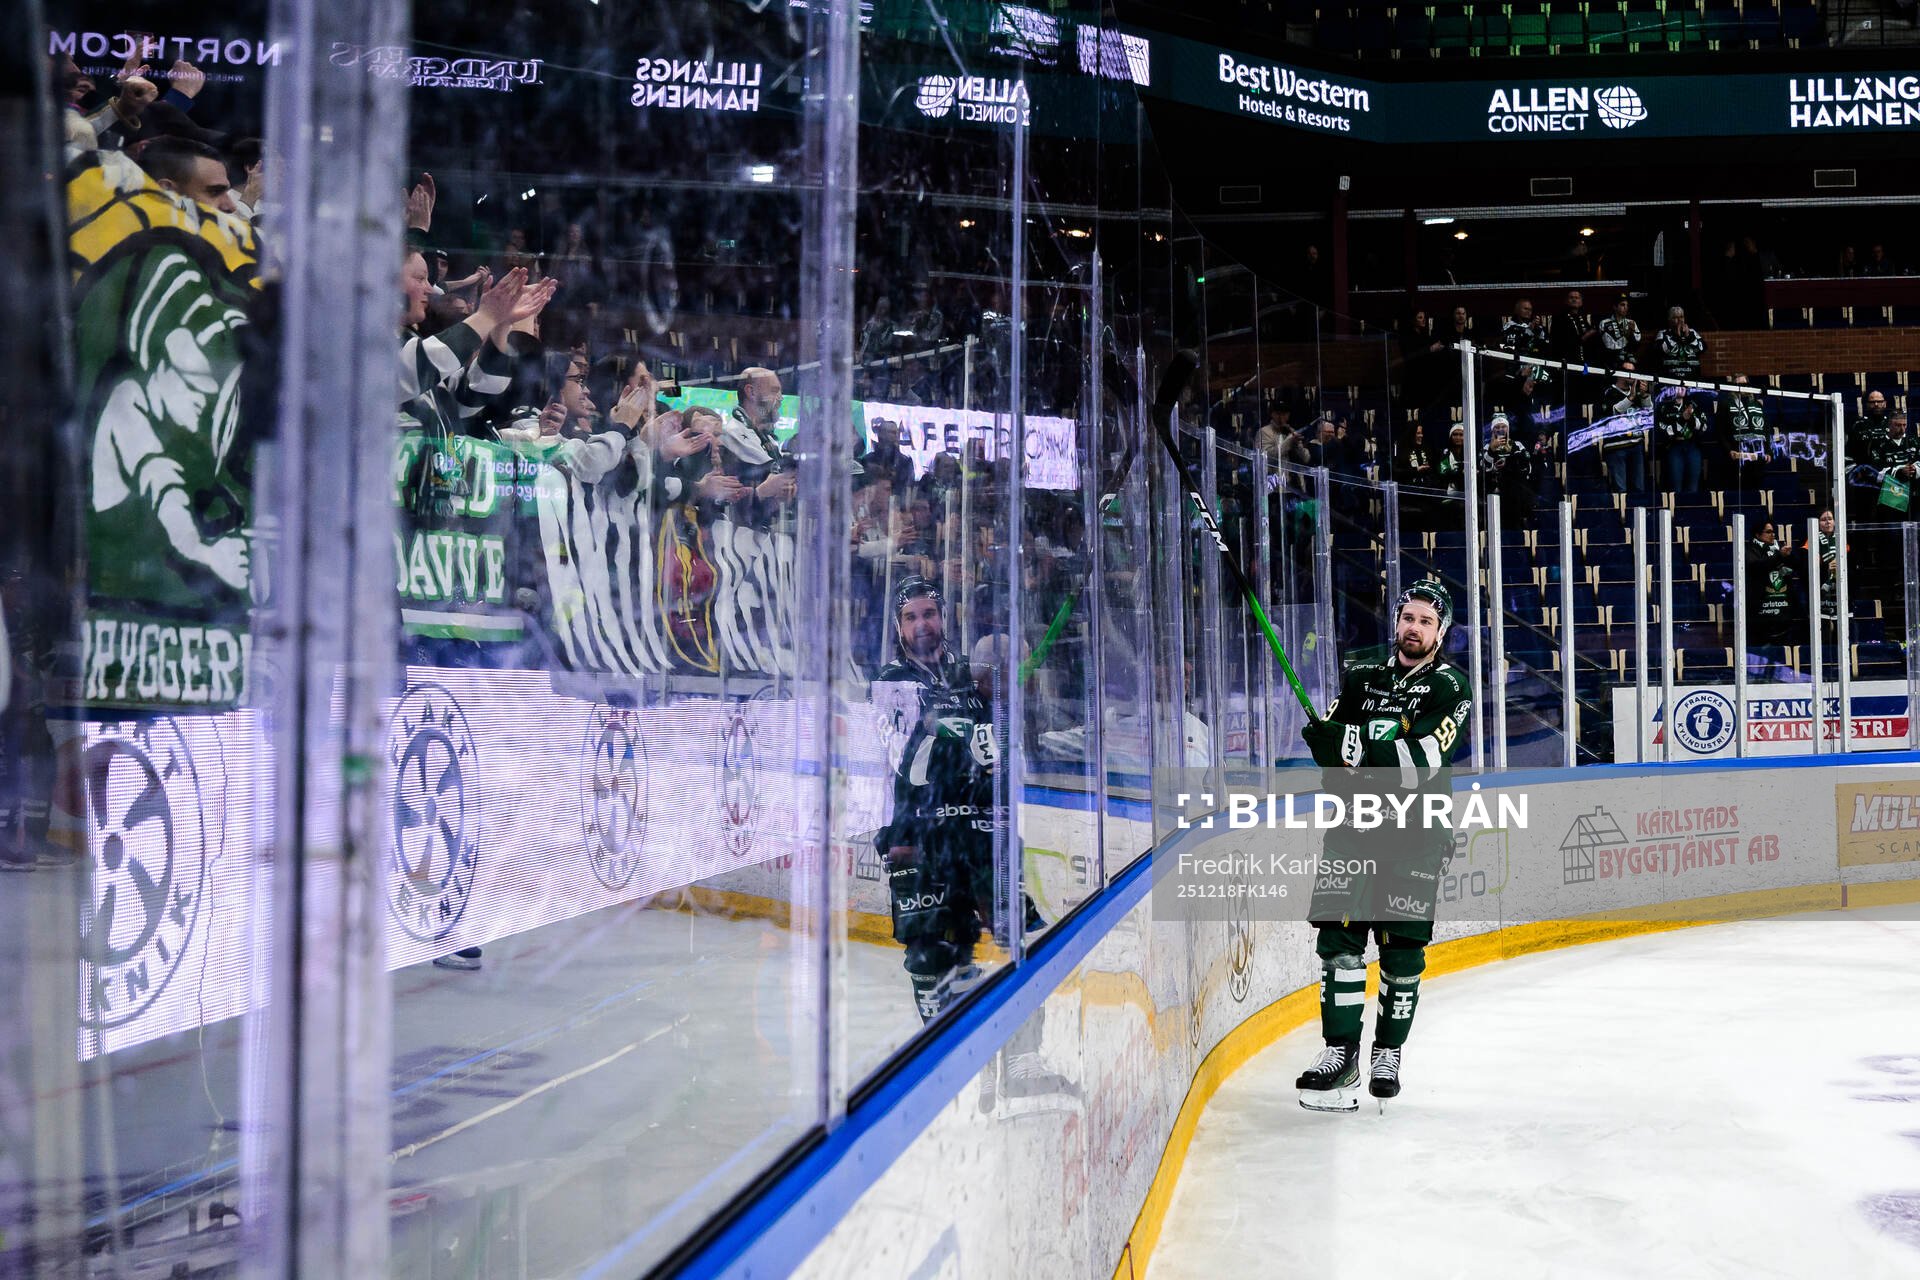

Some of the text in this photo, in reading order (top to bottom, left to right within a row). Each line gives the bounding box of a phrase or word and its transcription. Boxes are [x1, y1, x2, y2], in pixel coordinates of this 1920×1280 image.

[1219, 53, 1370, 112] Best Western
[1790, 75, 1920, 102] LILLÄNG
[1239, 94, 1350, 132] Hotels & Resorts
[1488, 87, 1589, 113] ALLEN
[1488, 113, 1588, 133] CONNECT
[1790, 102, 1920, 128] HAMNEN
[1190, 492, 1229, 551] CCM
[1684, 695, 1723, 709] FRANCKS
[1434, 715, 1457, 752] 59
[1677, 721, 1726, 749] KYLINDUSTRI
[1636, 805, 1740, 836] KARLSTADS
[1599, 834, 1780, 880] BYGGTJÄNST AB
[1410, 870, 1436, 880] CCM
[1437, 869, 1486, 904] ero
[1387, 893, 1428, 915] voky
